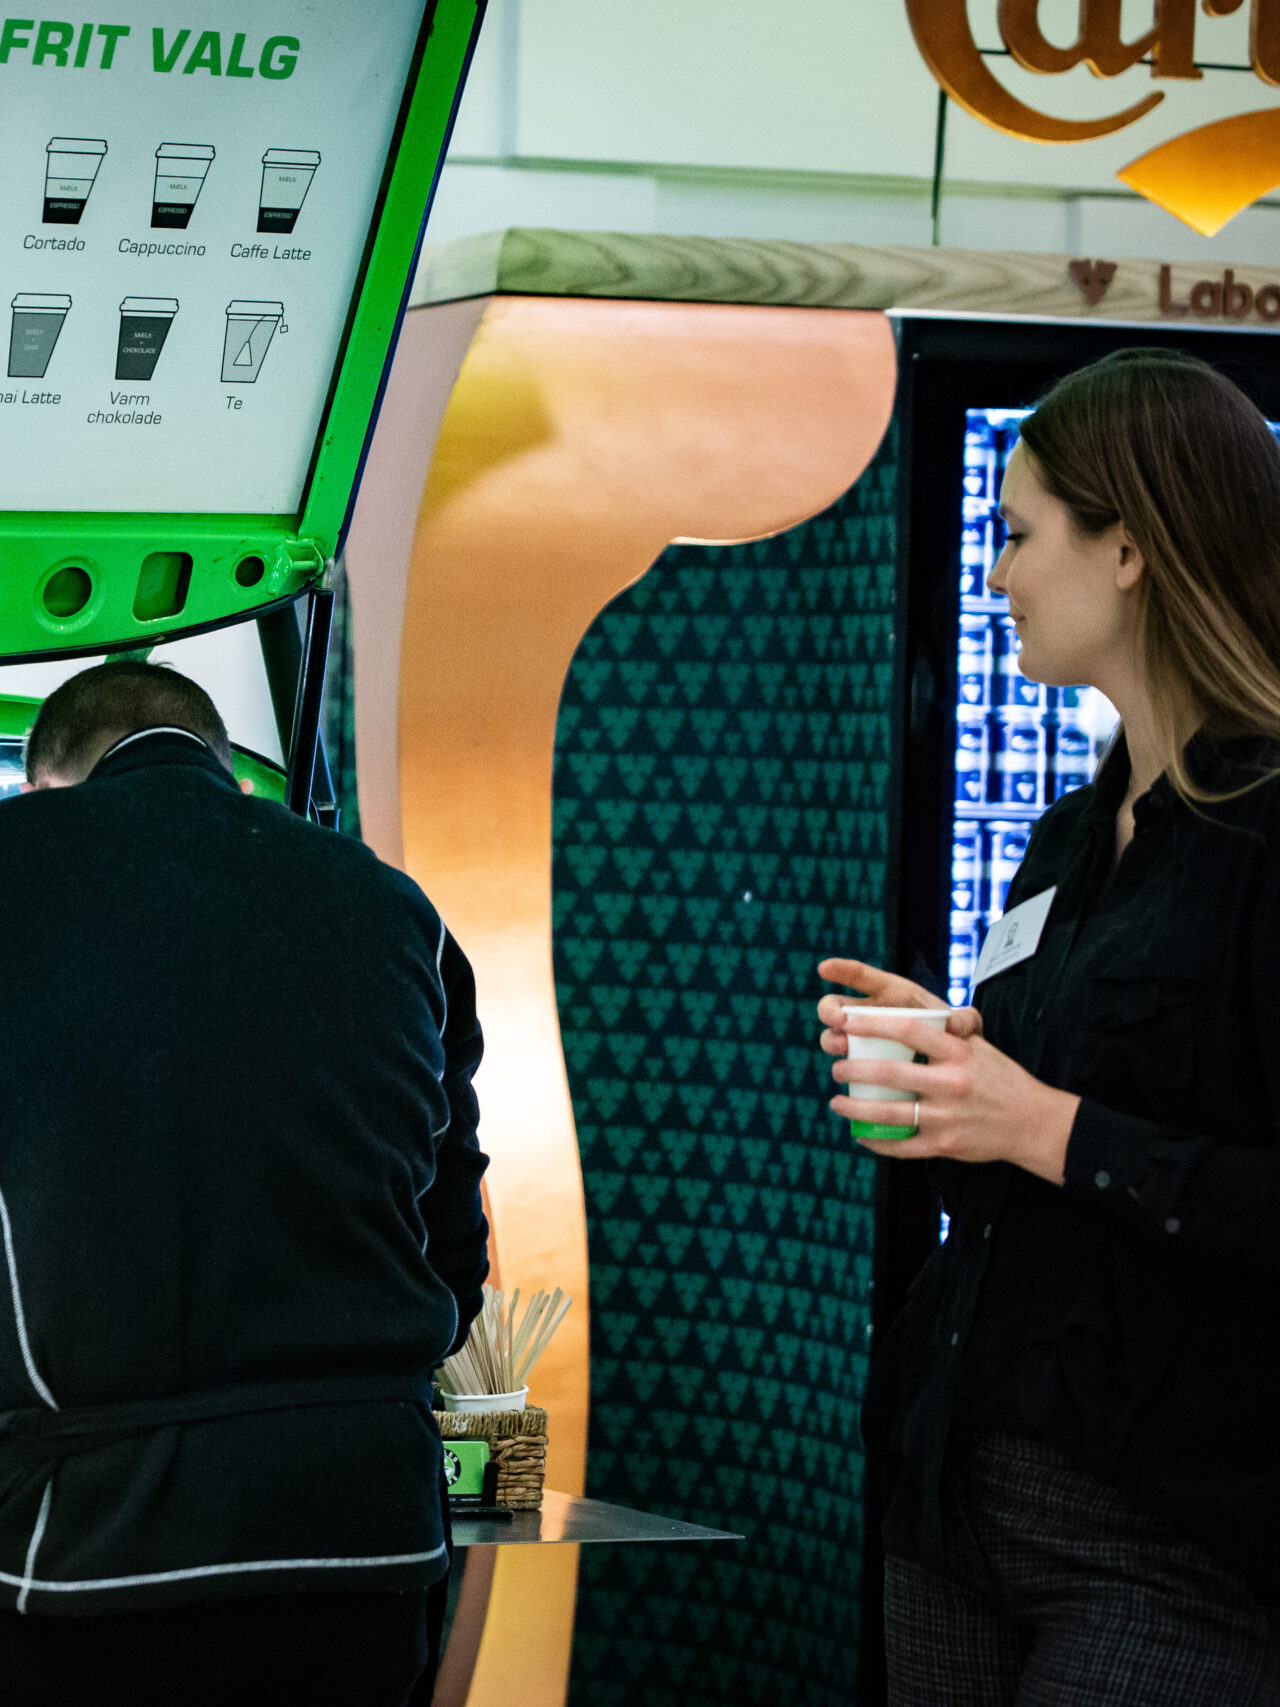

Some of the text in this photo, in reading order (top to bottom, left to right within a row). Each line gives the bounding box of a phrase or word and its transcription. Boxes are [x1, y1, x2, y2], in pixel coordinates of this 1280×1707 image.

[151, 27, 301, 80] VALG
[49, 202, 81, 210] ESPRESSO
[157, 206, 188, 214] ESPRESSO
[263, 211, 294, 219] ESPRESSO
[23, 235, 86, 251] Cortado
[118, 238, 206, 258] Cappuccino
[230, 243, 312, 261] Caffe Latte
[22, 390, 62, 405] Latte
[110, 391, 150, 406] Varm
[226, 396, 243, 410] Te
[87, 410, 162, 425] chokolade
